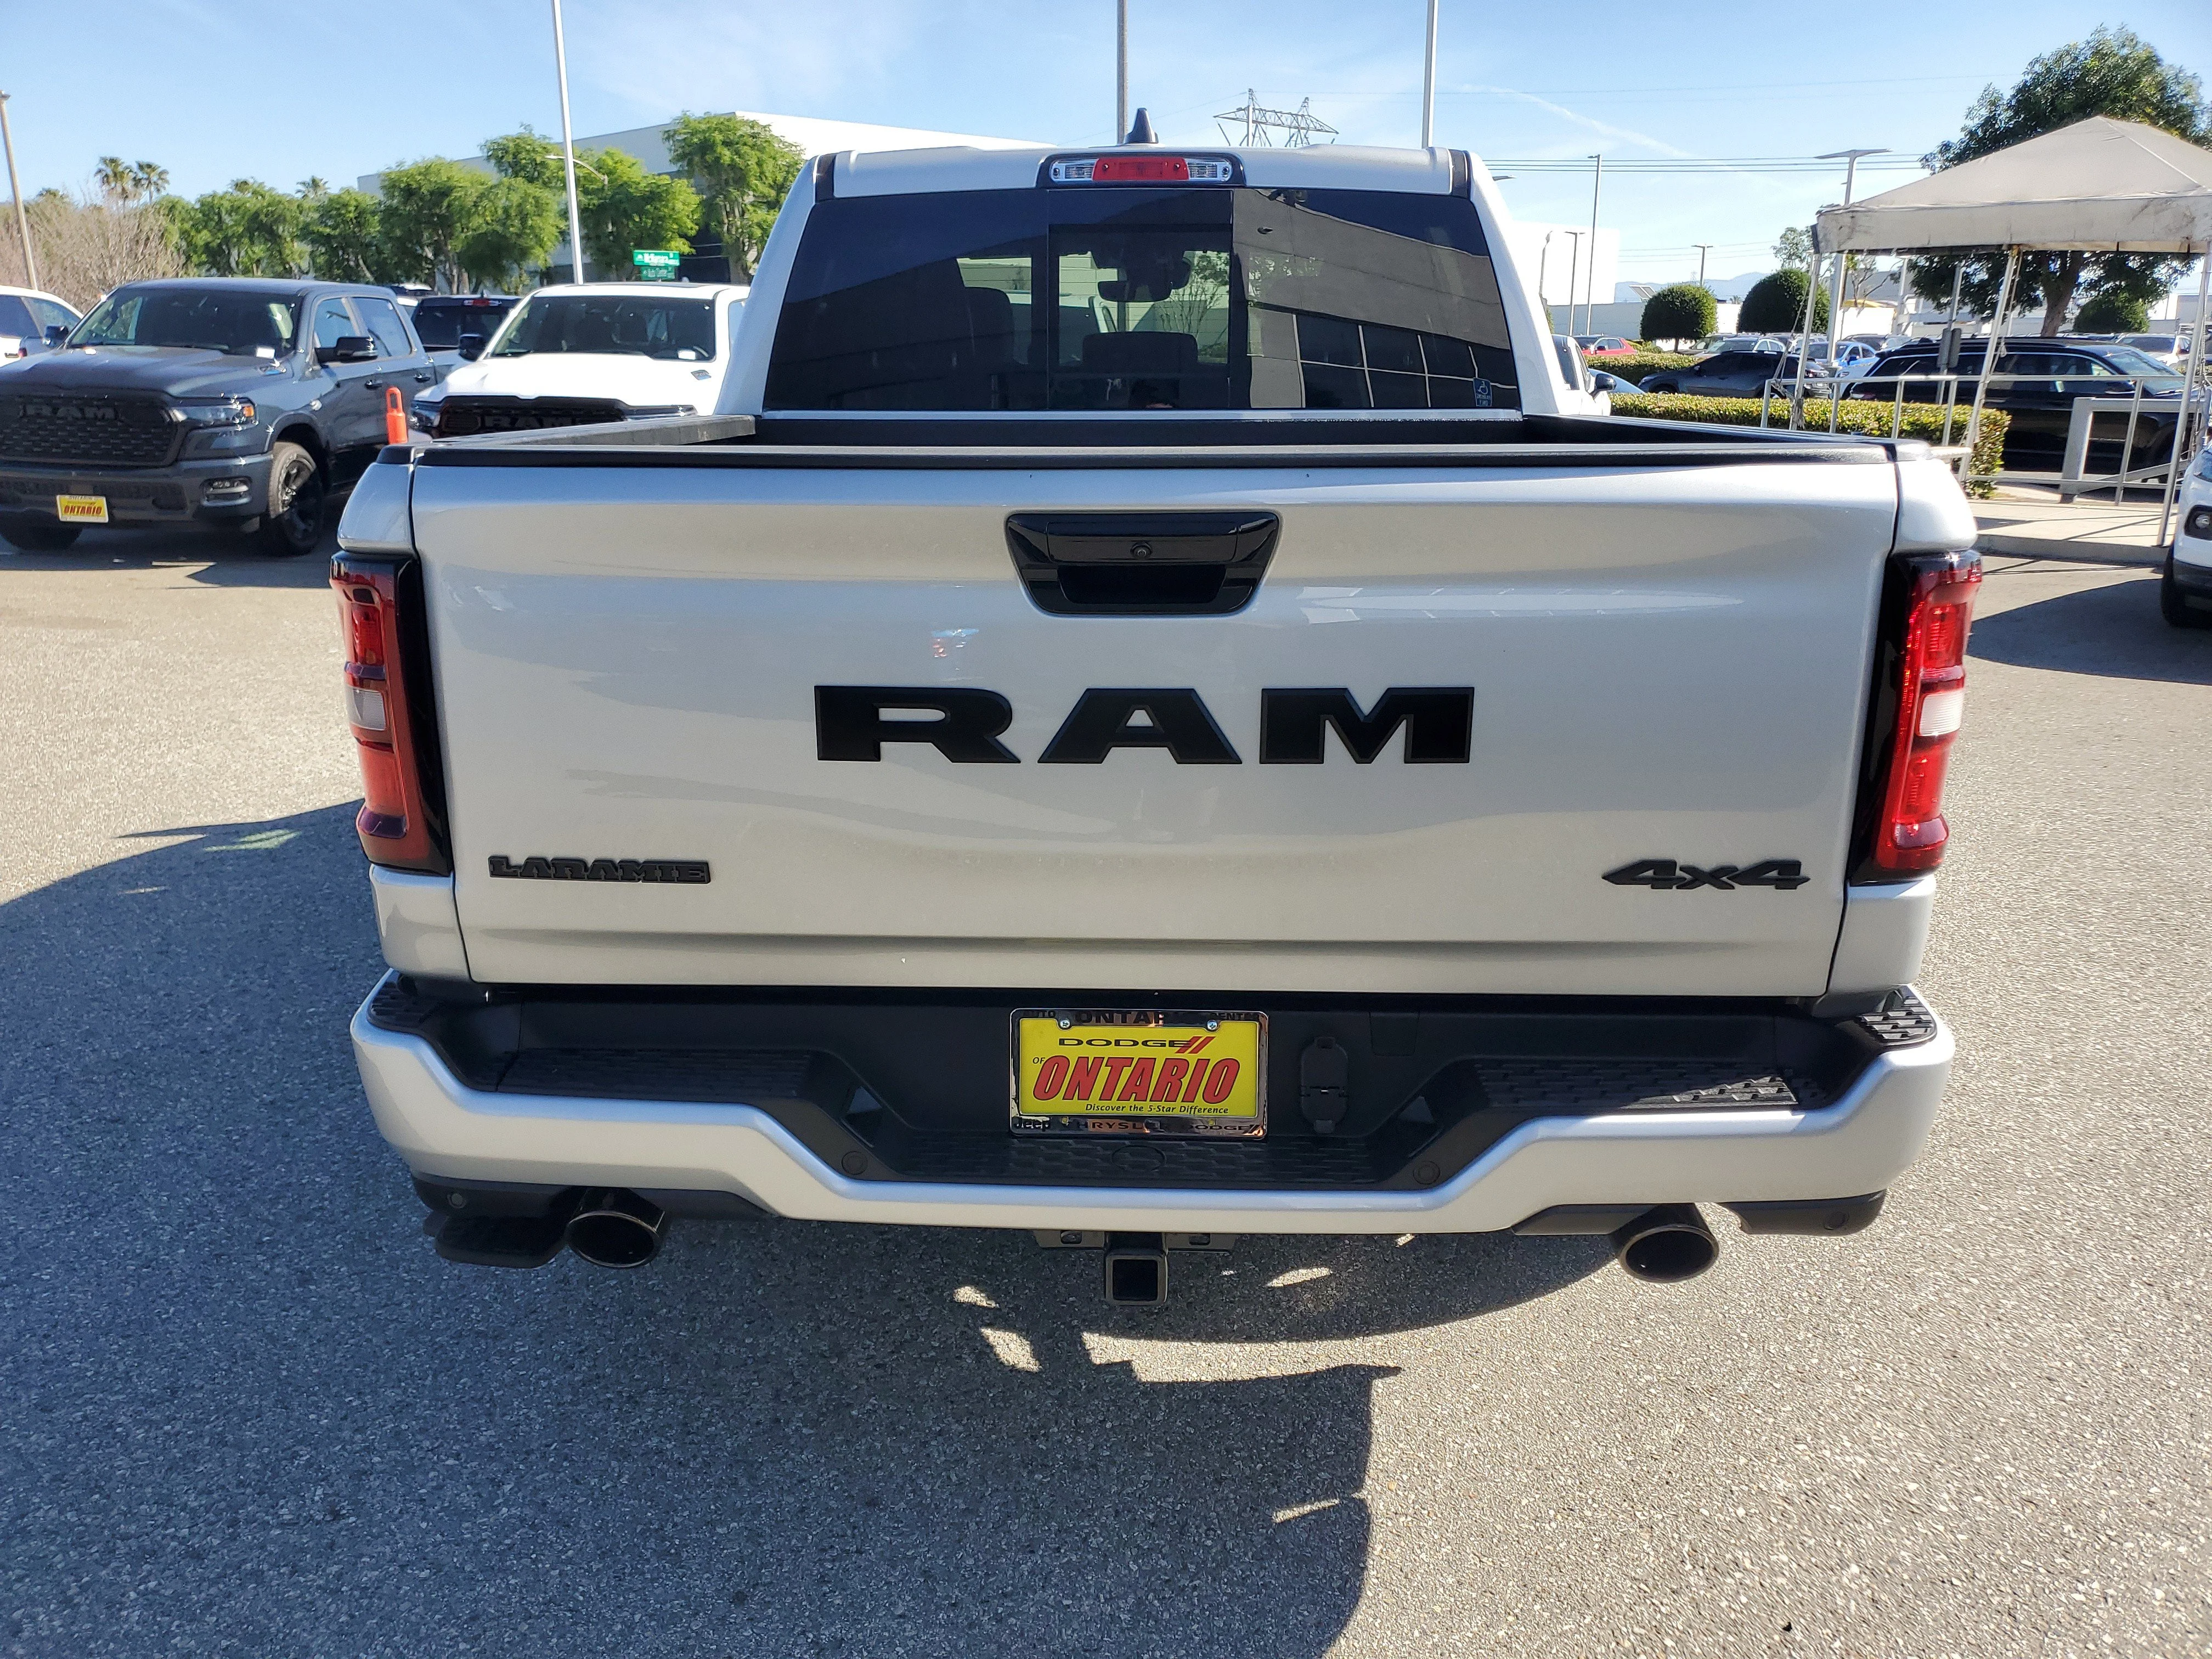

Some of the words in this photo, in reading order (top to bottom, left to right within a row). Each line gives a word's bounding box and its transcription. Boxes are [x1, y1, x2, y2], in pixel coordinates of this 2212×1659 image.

[814, 685, 1475, 764] RAM
[488, 856, 711, 884] LARAMIE
[1601, 859, 1811, 890] 4x4
[1059, 1038, 1192, 1047] DODGE
[1033, 1055, 1240, 1104] ONTARIO
[1086, 1103, 1126, 1112] Discover
[1147, 1105, 1176, 1113] 5-Star
[1180, 1105, 1229, 1116] Difference
